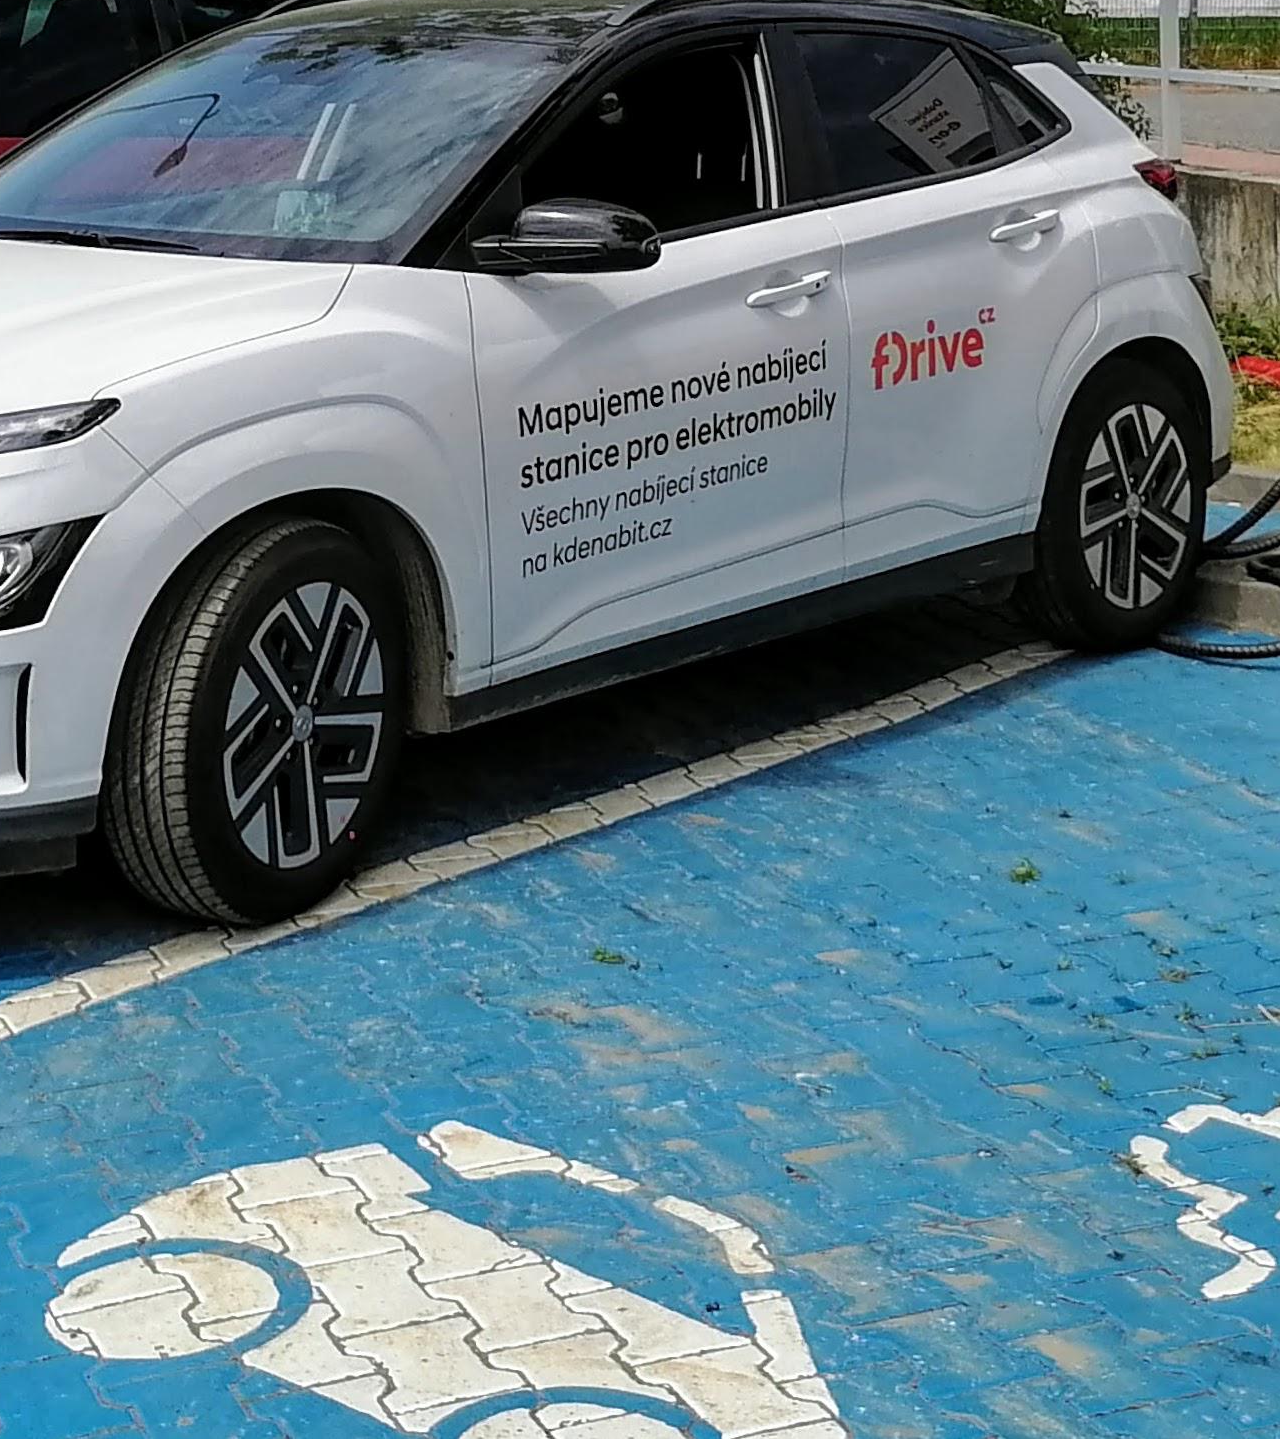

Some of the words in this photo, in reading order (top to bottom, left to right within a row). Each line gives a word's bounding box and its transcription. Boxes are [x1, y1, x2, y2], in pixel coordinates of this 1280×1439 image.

[518, 385, 665, 438] Mapujeme
[671, 361, 731, 404] nové
[737, 339, 827, 389] nabíjecí
[520, 441, 620, 489] stanice
[626, 432, 669, 470] pro
[675, 387, 837, 451] elektromobily
[521, 497, 611, 535] Všechny
[615, 465, 696, 512] nabíjecí
[699, 453, 768, 489] stanice
[523, 552, 547, 579] na
[553, 517, 673, 568] kdenabit.cz
